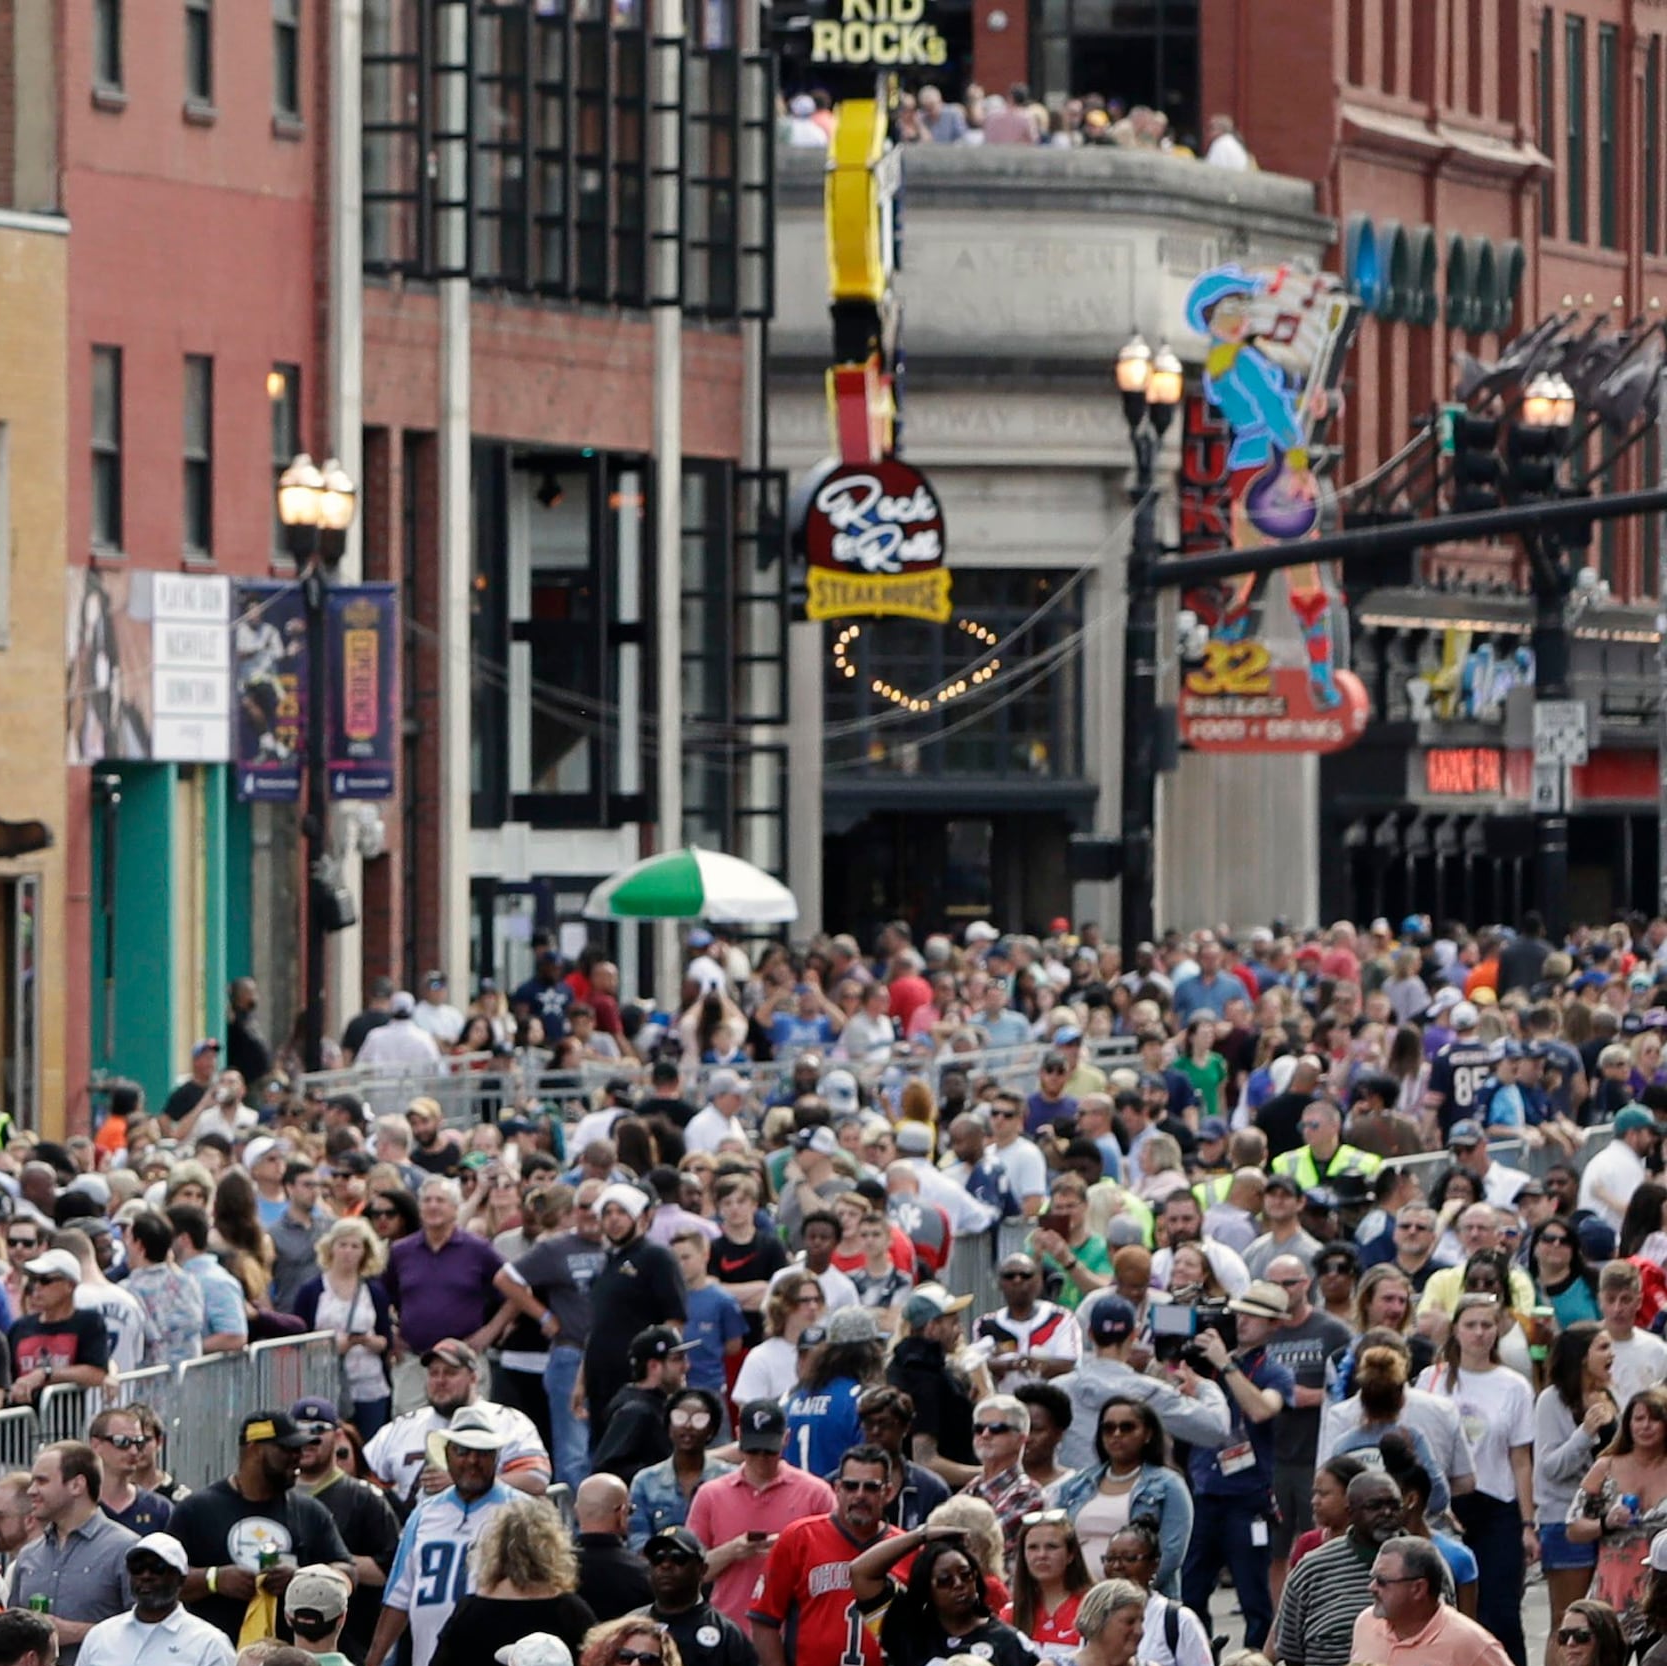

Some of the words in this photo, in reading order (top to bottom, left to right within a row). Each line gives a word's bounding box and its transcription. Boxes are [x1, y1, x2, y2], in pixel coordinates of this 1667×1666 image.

[842, 0, 924, 22] KID
[817, 474, 937, 530] Rock
[1186, 638, 1271, 694] 32
[796, 1423, 810, 1472] 1
